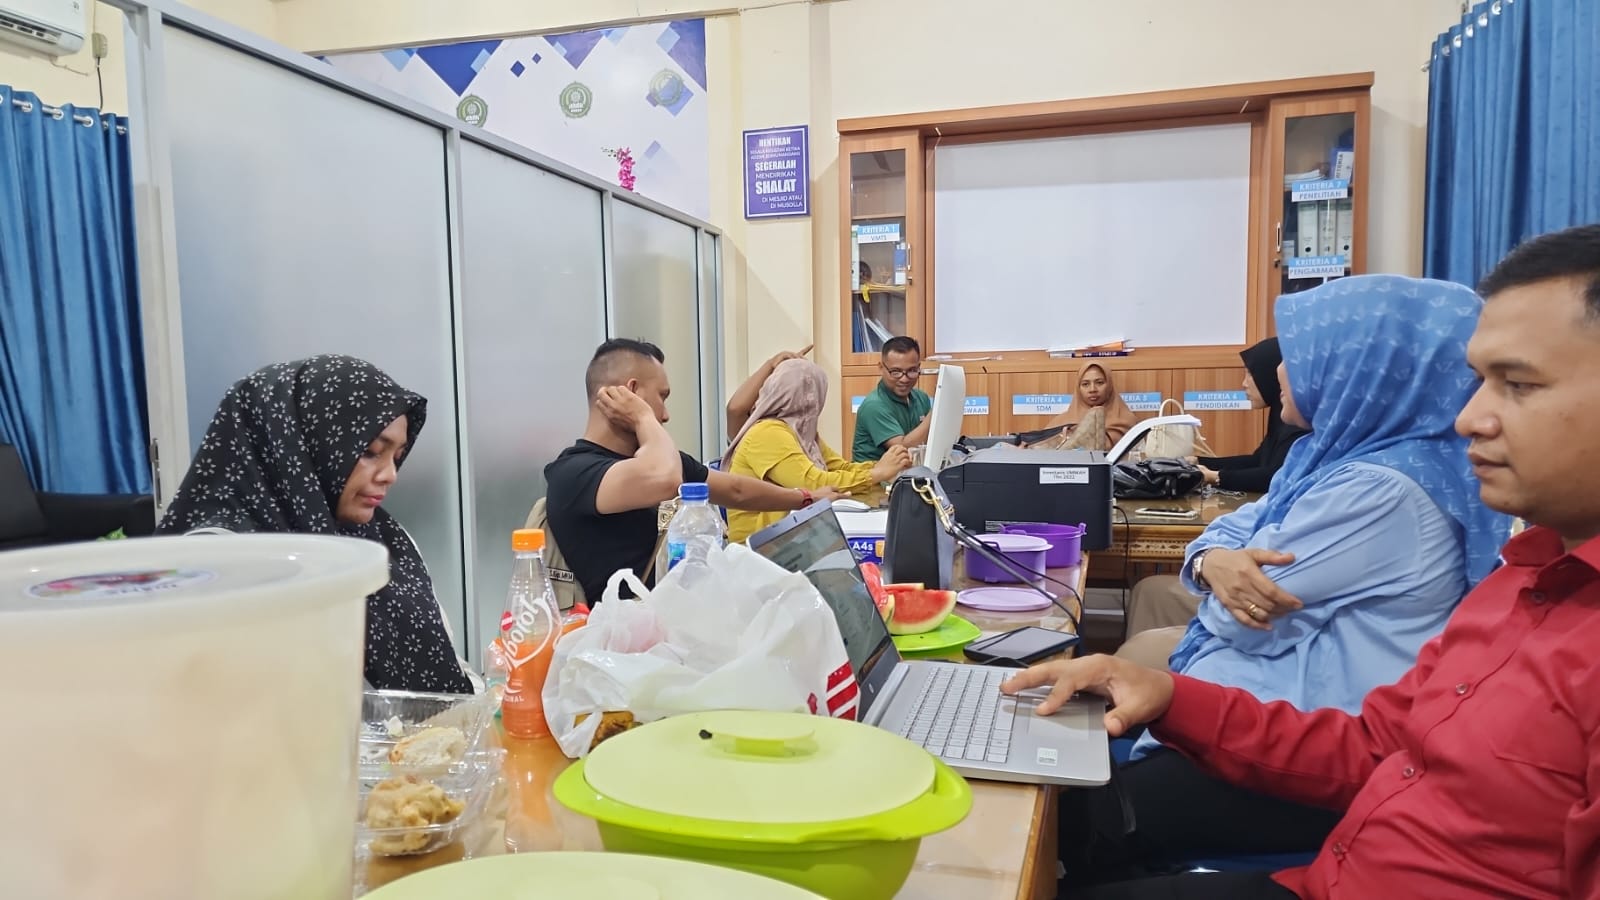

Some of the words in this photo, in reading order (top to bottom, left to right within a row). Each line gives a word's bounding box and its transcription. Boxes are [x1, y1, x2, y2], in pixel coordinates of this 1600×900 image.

[758, 136, 791, 147] HENTIKAN
[754, 159, 797, 172] SEGERALAH
[755, 170, 797, 179] MENDIRIKAN
[755, 178, 797, 195] SHALAT
[1299, 181, 1334, 191] KRITERIA
[1335, 180, 1342, 188] 7
[1300, 191, 1342, 200] PENELITIAN
[862, 226, 890, 235] KRITERIA
[1295, 258, 1330, 268] KRITERIA
[1025, 396, 1055, 404] KRITERIA
[1198, 393, 1231, 401] KRITERIA
[852, 541, 874, 551] A4s
